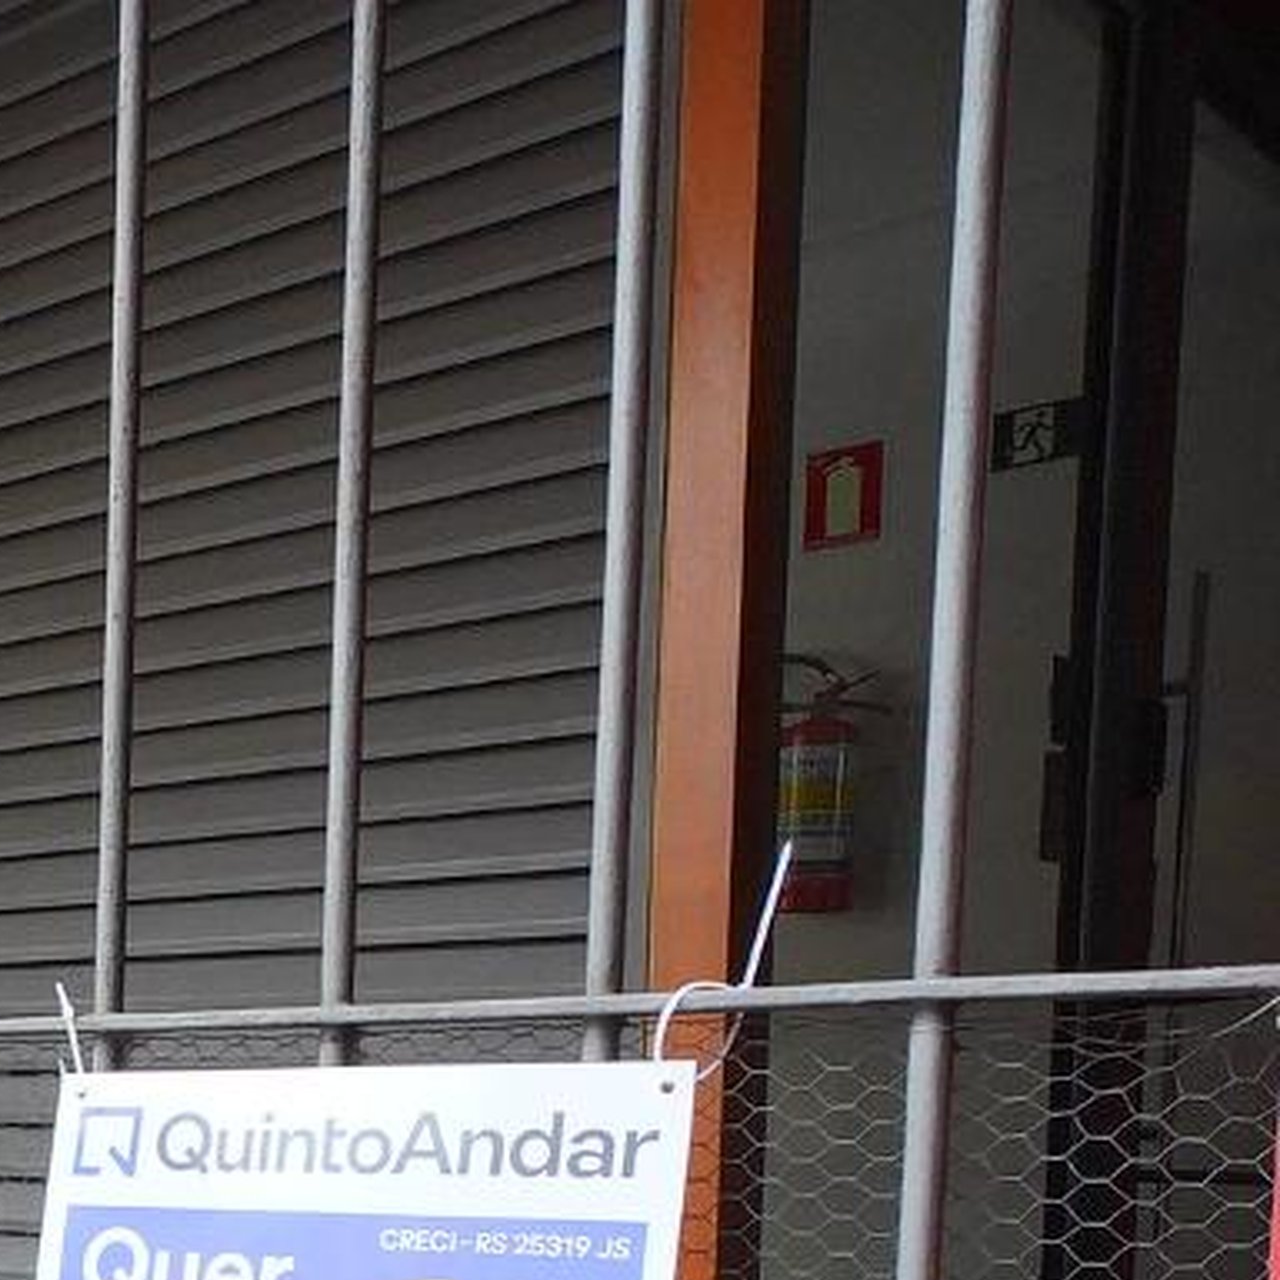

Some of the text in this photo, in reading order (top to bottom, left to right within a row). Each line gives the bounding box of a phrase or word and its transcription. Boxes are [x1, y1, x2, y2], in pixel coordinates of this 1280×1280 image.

[156, 1112, 661, 1178] QuintoAndar
[514, 1231, 592, 1259] 25319
[596, 1236, 632, 1259] JS
